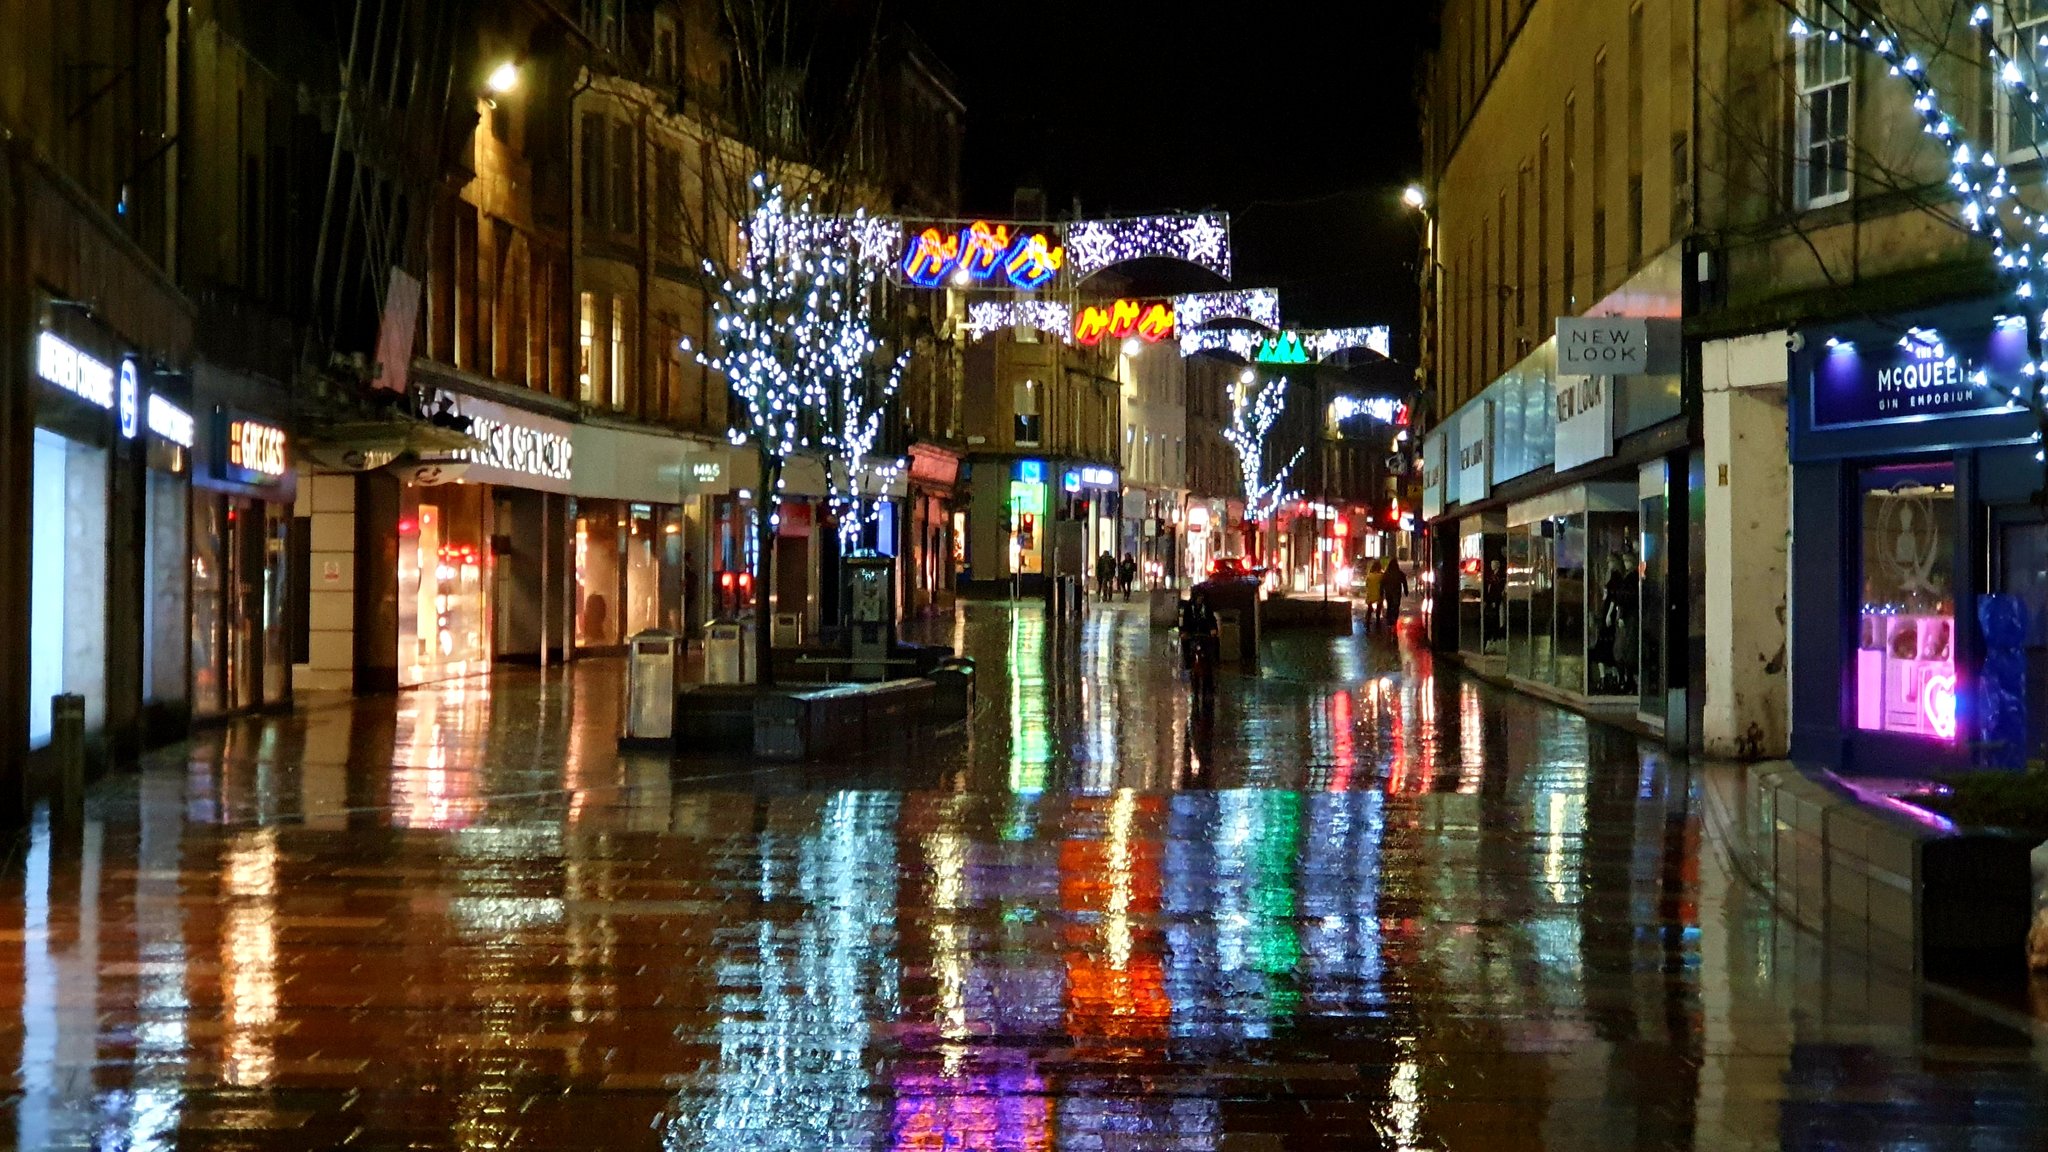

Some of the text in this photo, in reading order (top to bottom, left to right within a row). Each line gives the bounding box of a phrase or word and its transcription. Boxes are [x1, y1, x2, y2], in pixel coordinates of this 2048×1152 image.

[1572, 329, 1629, 344] NEW
[1567, 346, 1636, 361] LOOK
[1879, 390, 1973, 411] GIN EMPORIUM
[242, 421, 286, 475] GREGGS
[693, 463, 721, 477] M&S
